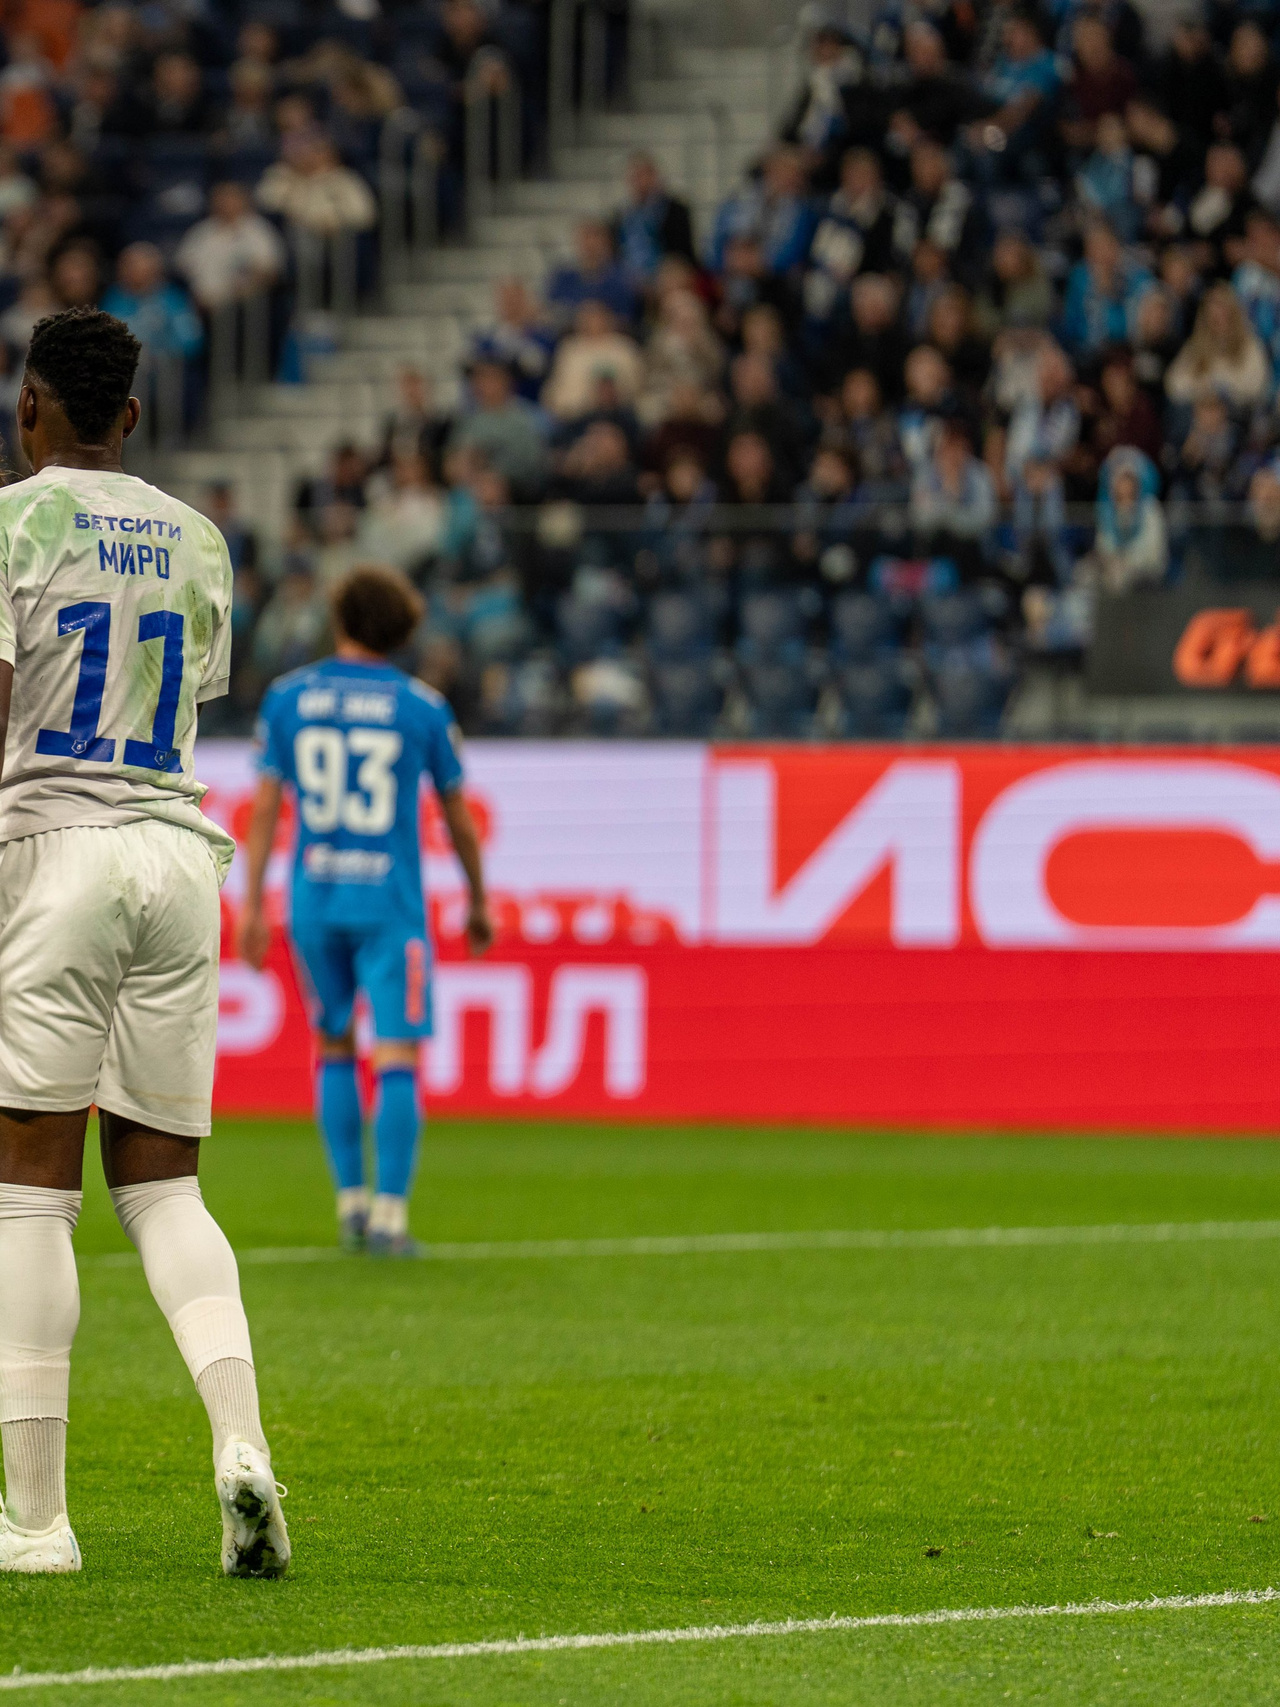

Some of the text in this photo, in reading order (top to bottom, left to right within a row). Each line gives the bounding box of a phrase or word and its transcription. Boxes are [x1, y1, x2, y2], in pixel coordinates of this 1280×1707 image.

[73, 512, 182, 541] БЕТСИТИ
[98, 539, 170, 580] МИРО
[34, 601, 184, 774] 11
[294, 726, 403, 836] 93
